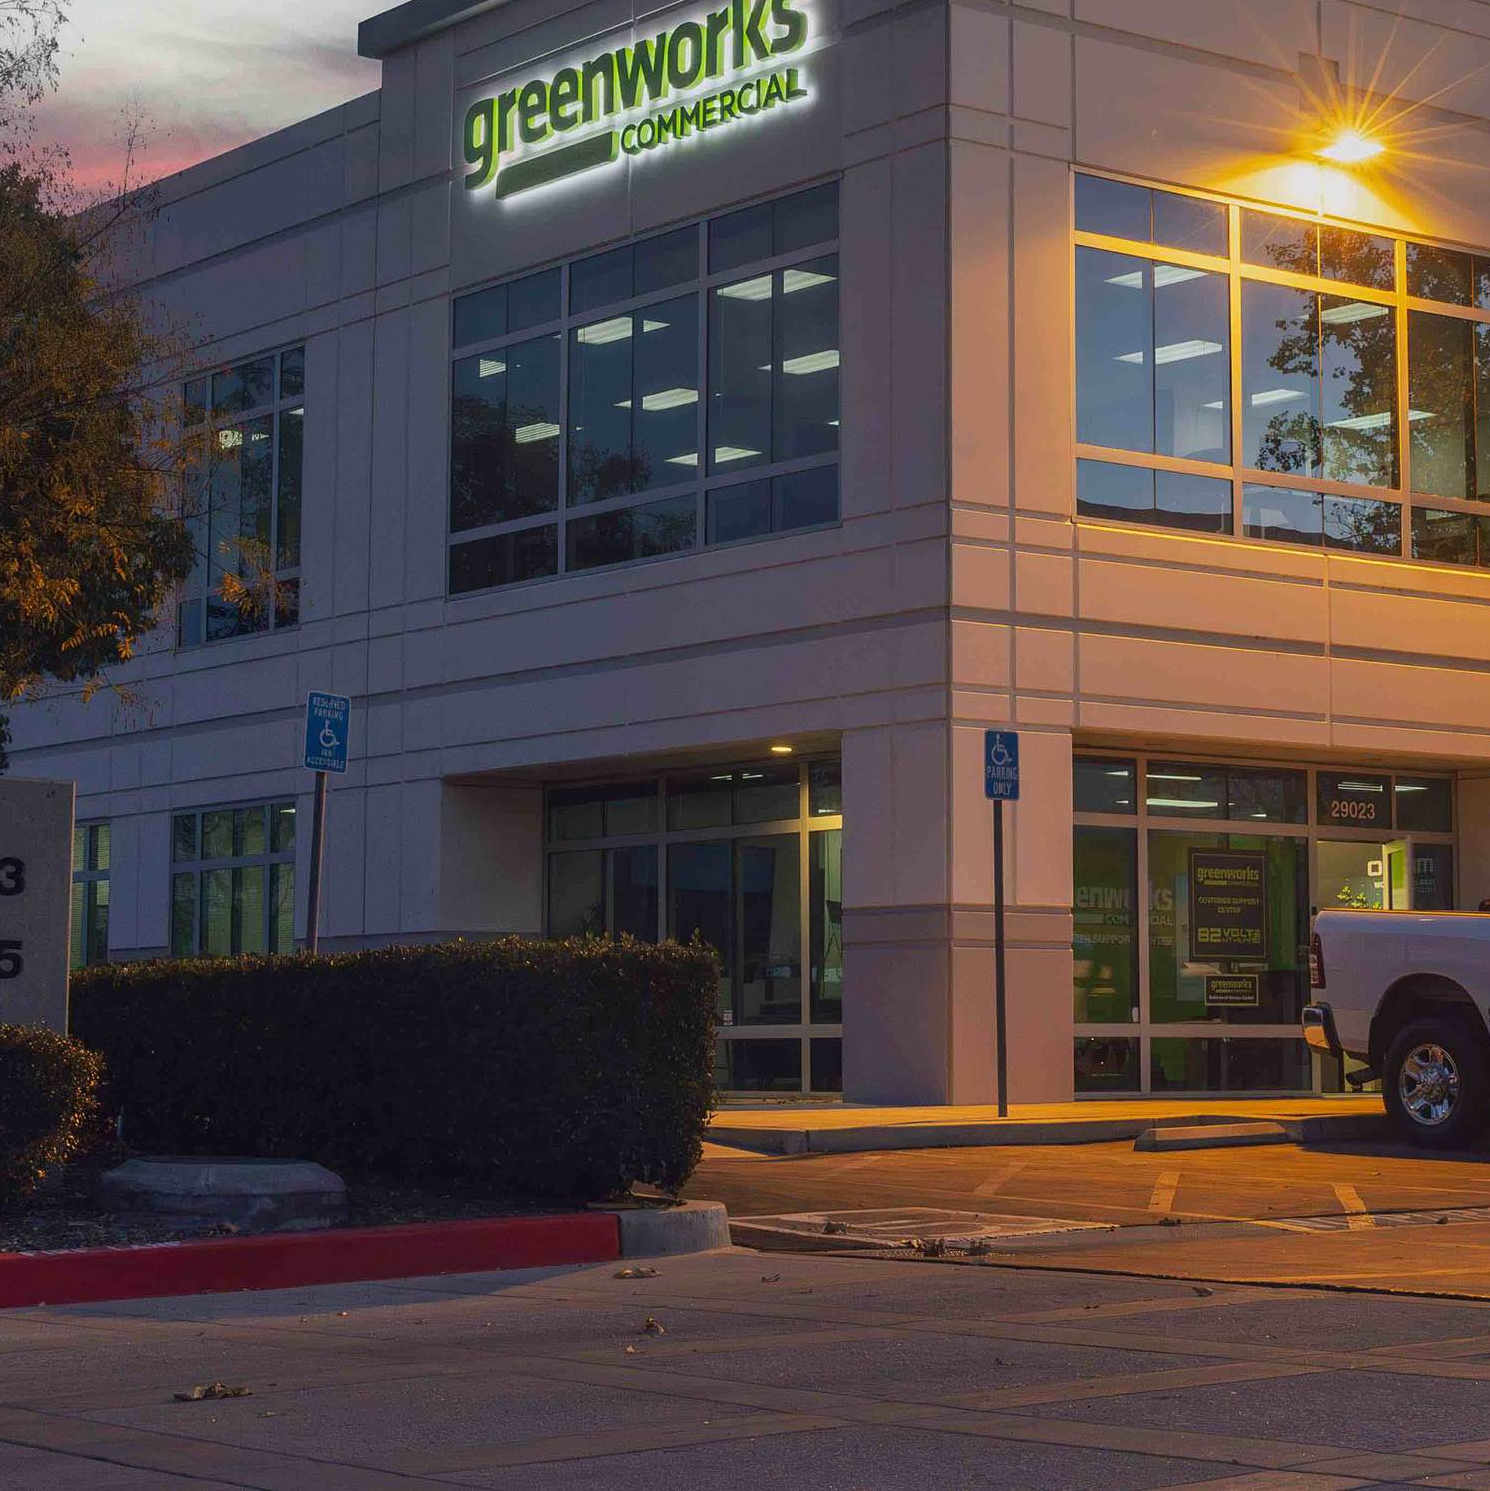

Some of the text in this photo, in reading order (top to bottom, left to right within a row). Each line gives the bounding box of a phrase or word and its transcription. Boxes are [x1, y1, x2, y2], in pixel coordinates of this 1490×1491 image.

[620, 67, 808, 156] COMMERCIAL
[987, 765, 1018, 781] PARKING
[992, 781, 1012, 796] ONLY
[1330, 800, 1376, 820] 29023
[1197, 863, 1260, 882] greenworks
[1198, 927, 1222, 943] 82
